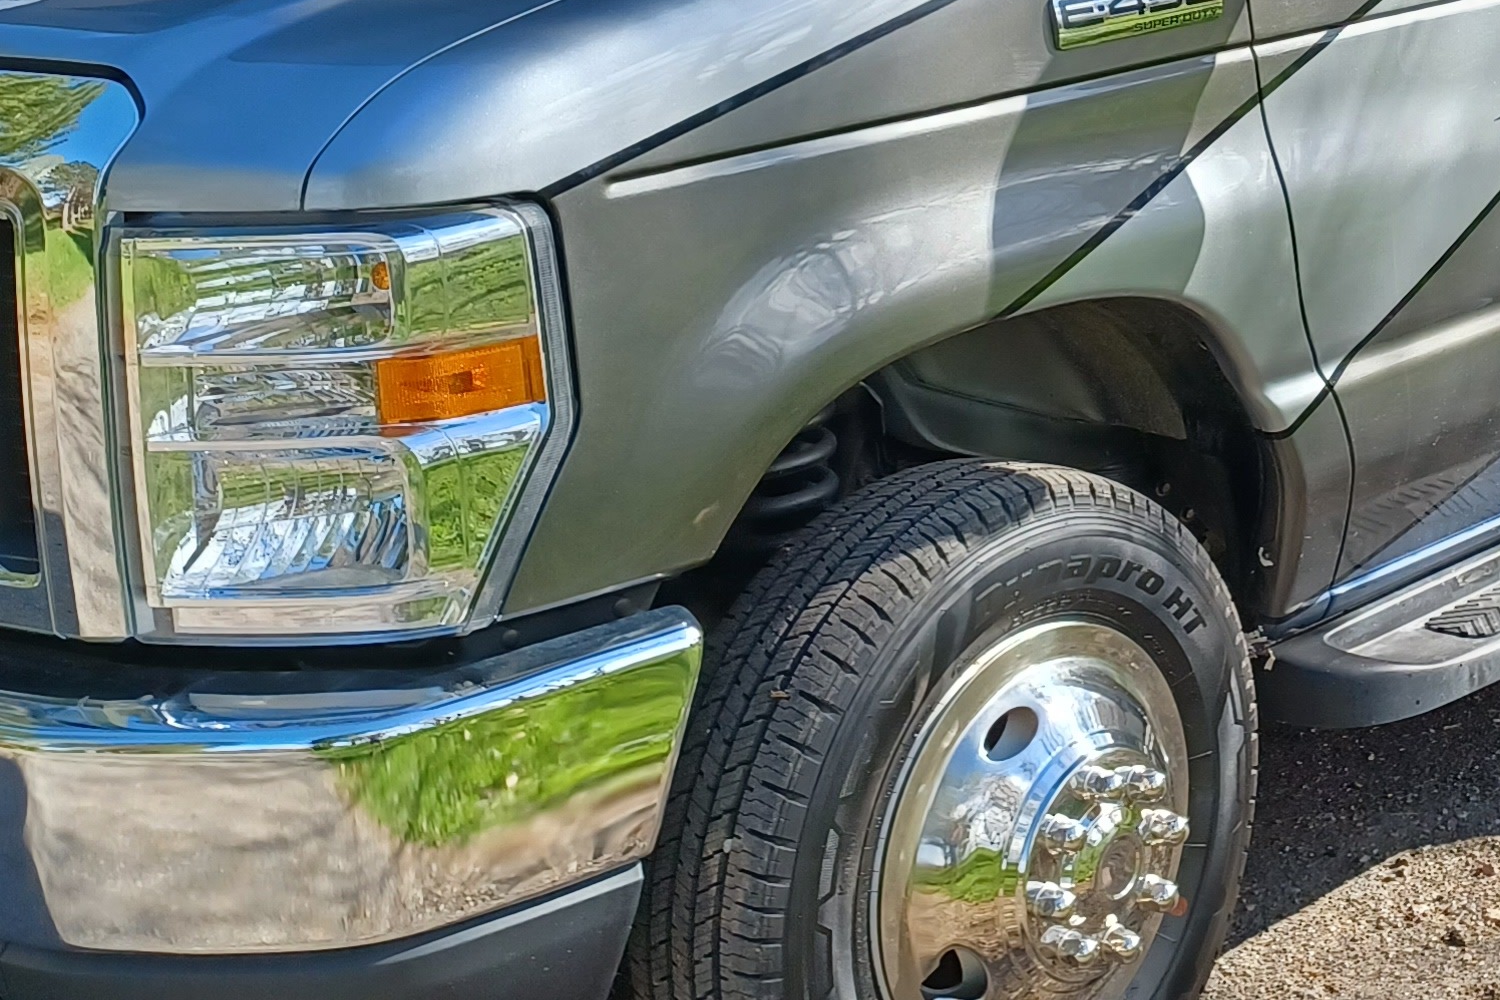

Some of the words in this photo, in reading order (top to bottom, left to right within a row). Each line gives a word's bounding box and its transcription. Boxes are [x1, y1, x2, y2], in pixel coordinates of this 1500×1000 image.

[1133, 17, 1180, 32] SUPER
[1181, 7, 1219, 23] DUTY
[975, 553, 1165, 622] napro
[1162, 586, 1207, 635] HT
